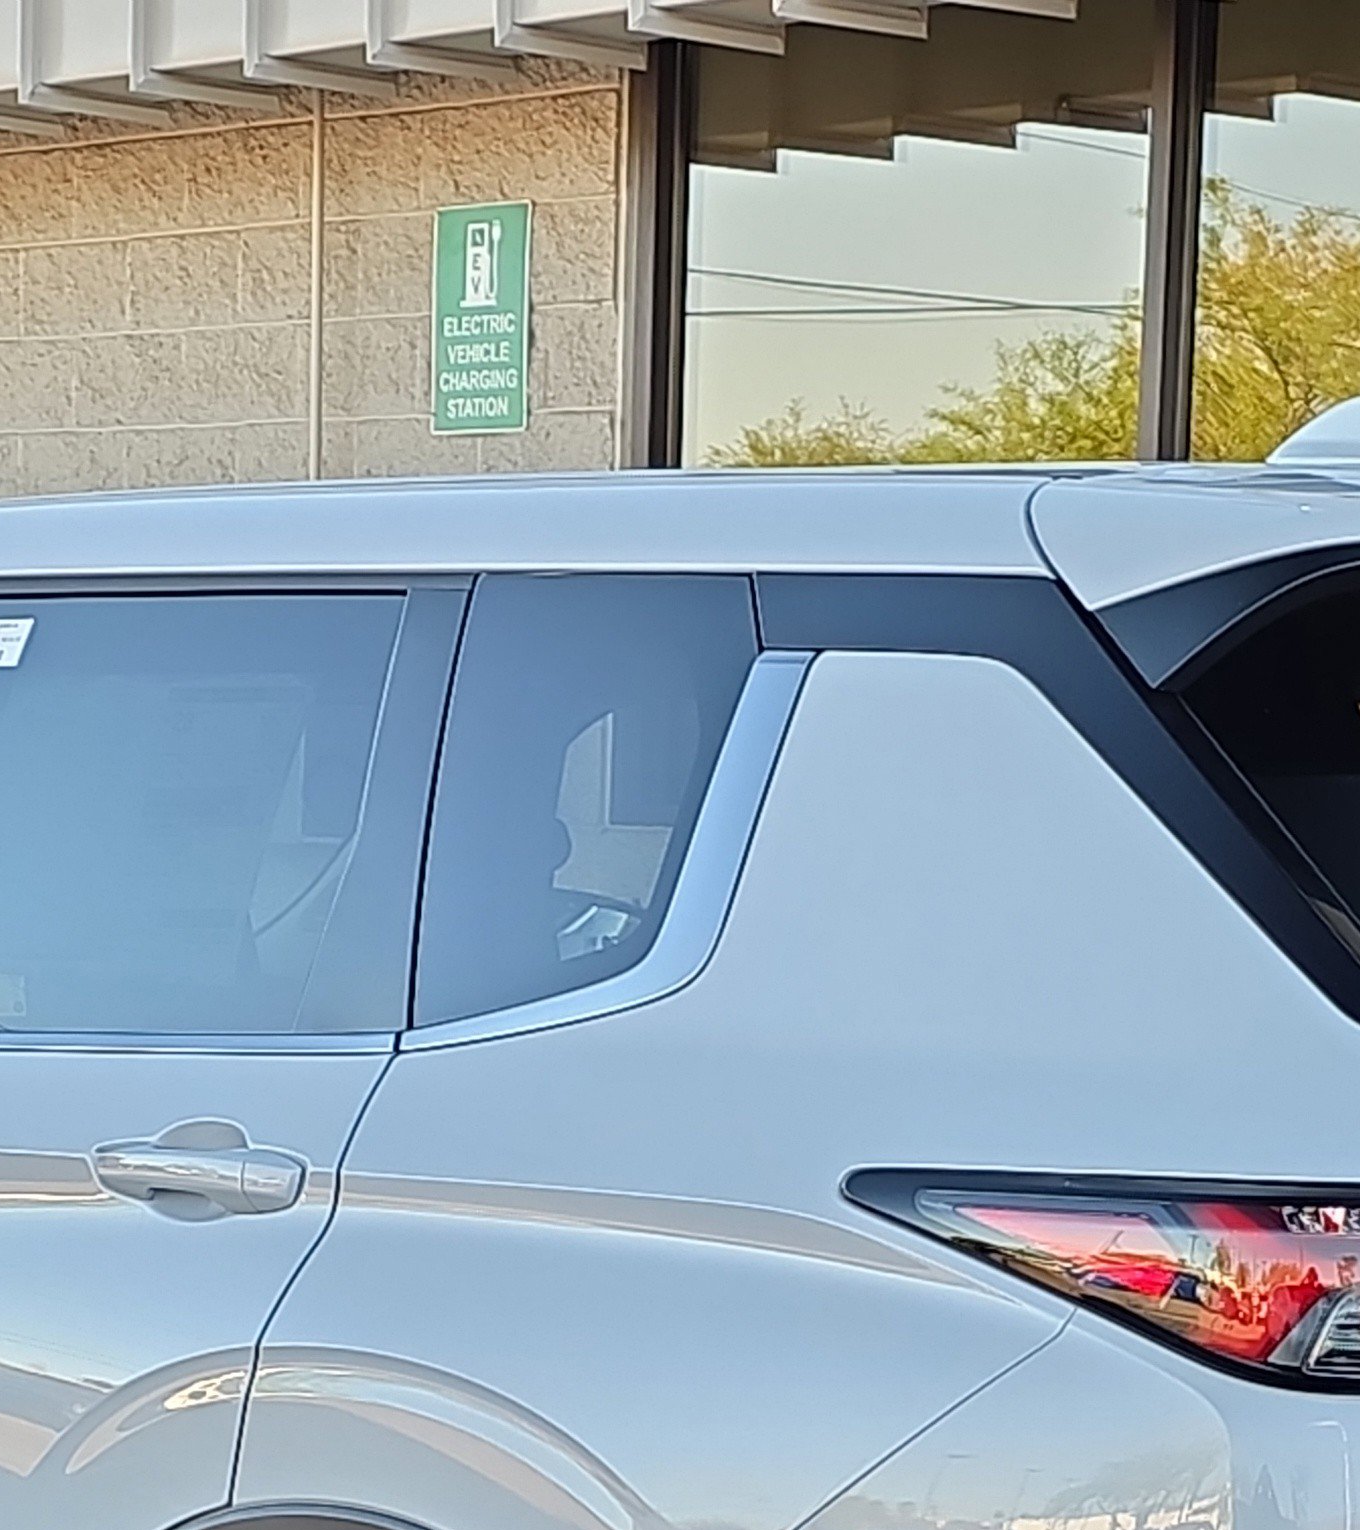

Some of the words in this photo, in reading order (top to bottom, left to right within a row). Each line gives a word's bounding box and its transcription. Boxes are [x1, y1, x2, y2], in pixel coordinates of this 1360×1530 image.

[443, 313, 516, 337] ELECTRIC
[447, 341, 511, 364] VEHICLE
[439, 368, 518, 392] CHARGING
[447, 396, 509, 419] STATION
